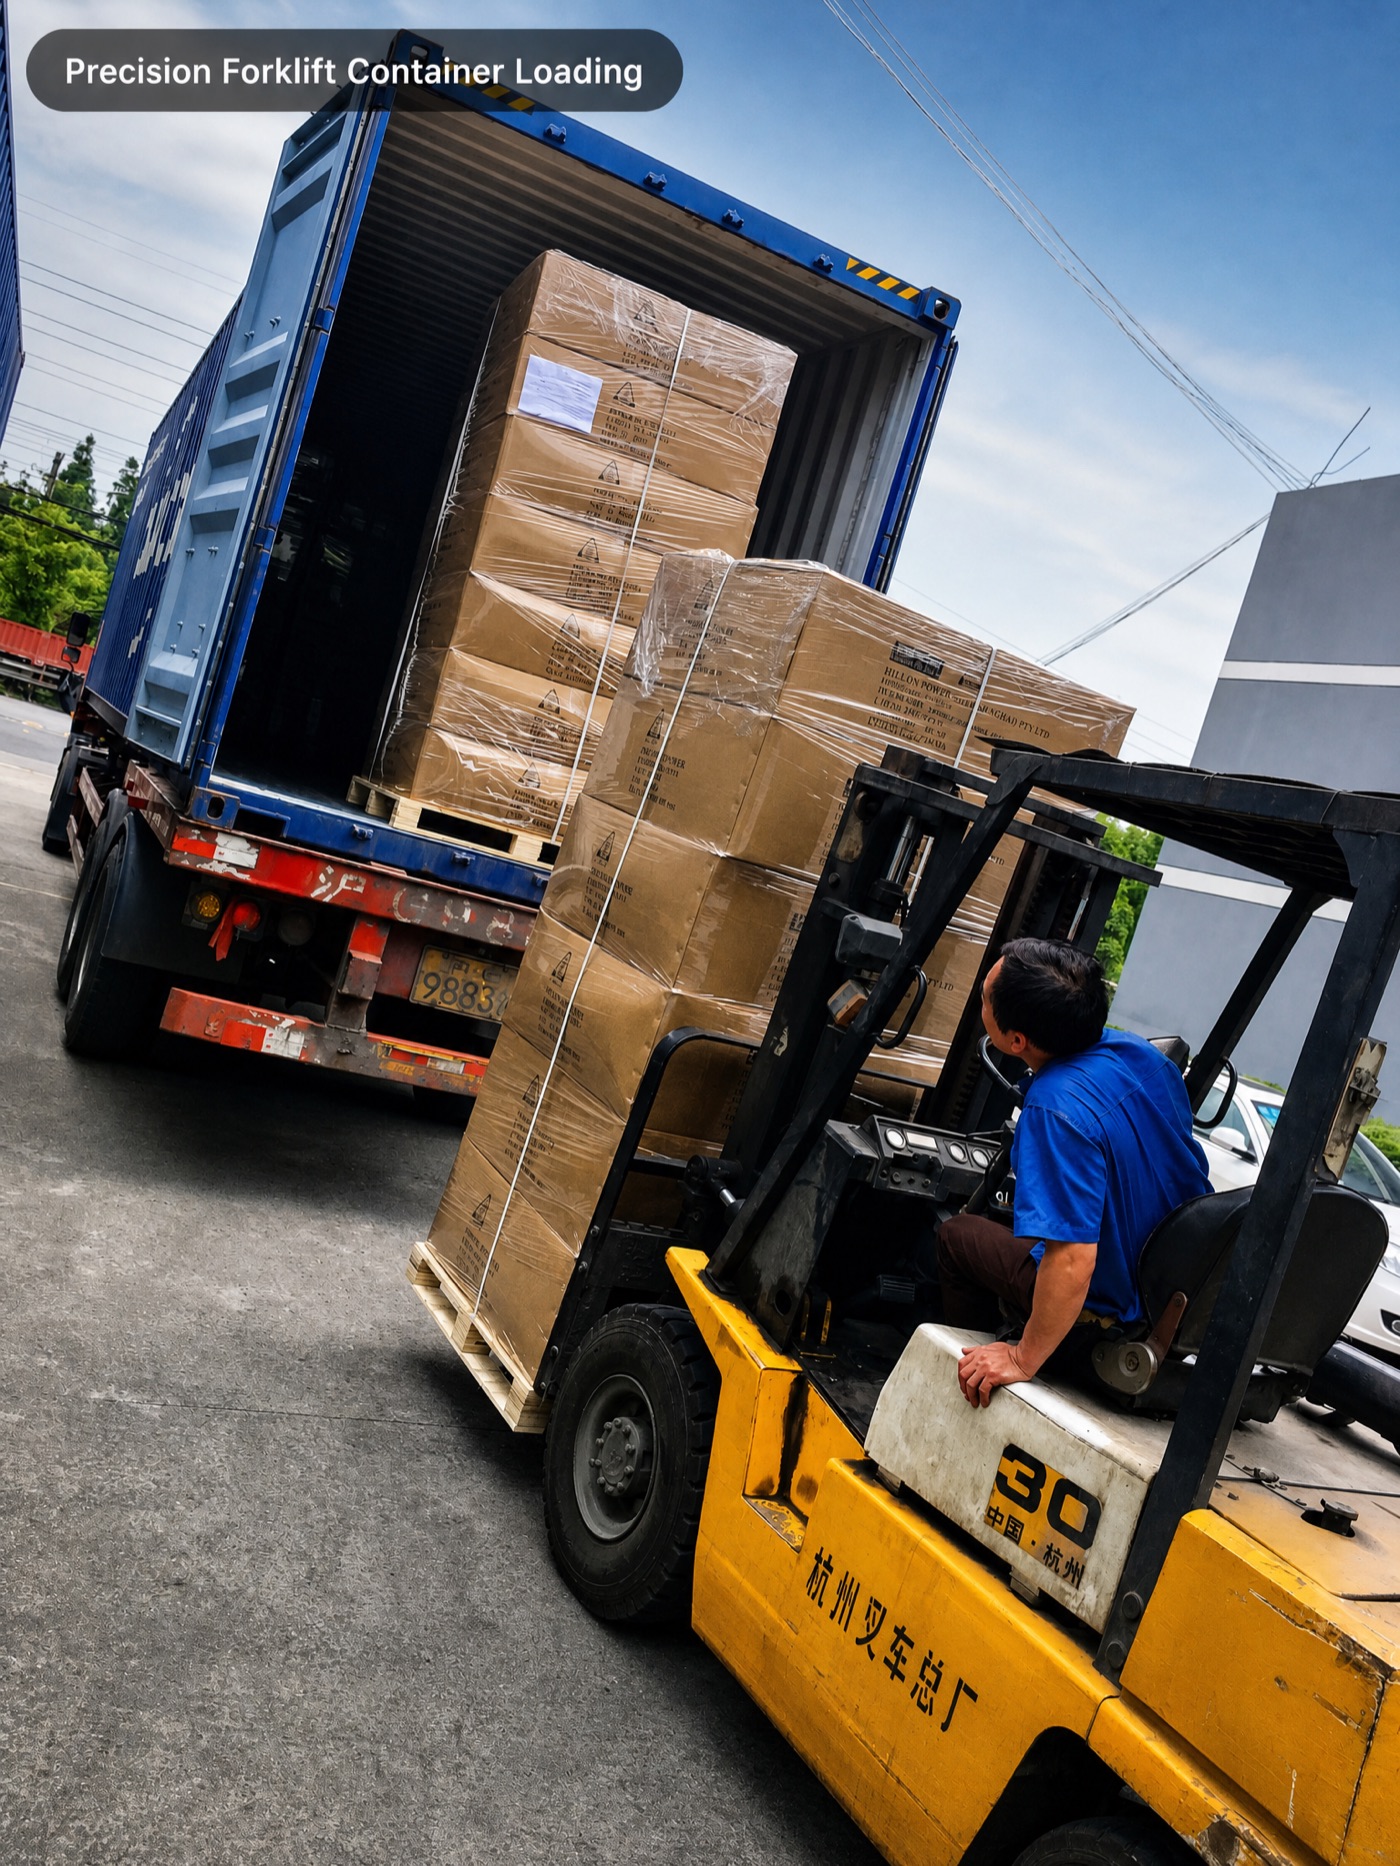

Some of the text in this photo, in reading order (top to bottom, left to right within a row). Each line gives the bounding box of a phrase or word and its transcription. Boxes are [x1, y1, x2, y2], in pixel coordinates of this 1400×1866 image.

[920, 680, 951, 699] POWER
[1034, 726, 1050, 739] LTD
[995, 1442, 1104, 1551] 30
[805, 1546, 979, 1733] 杭州叉车总厂
